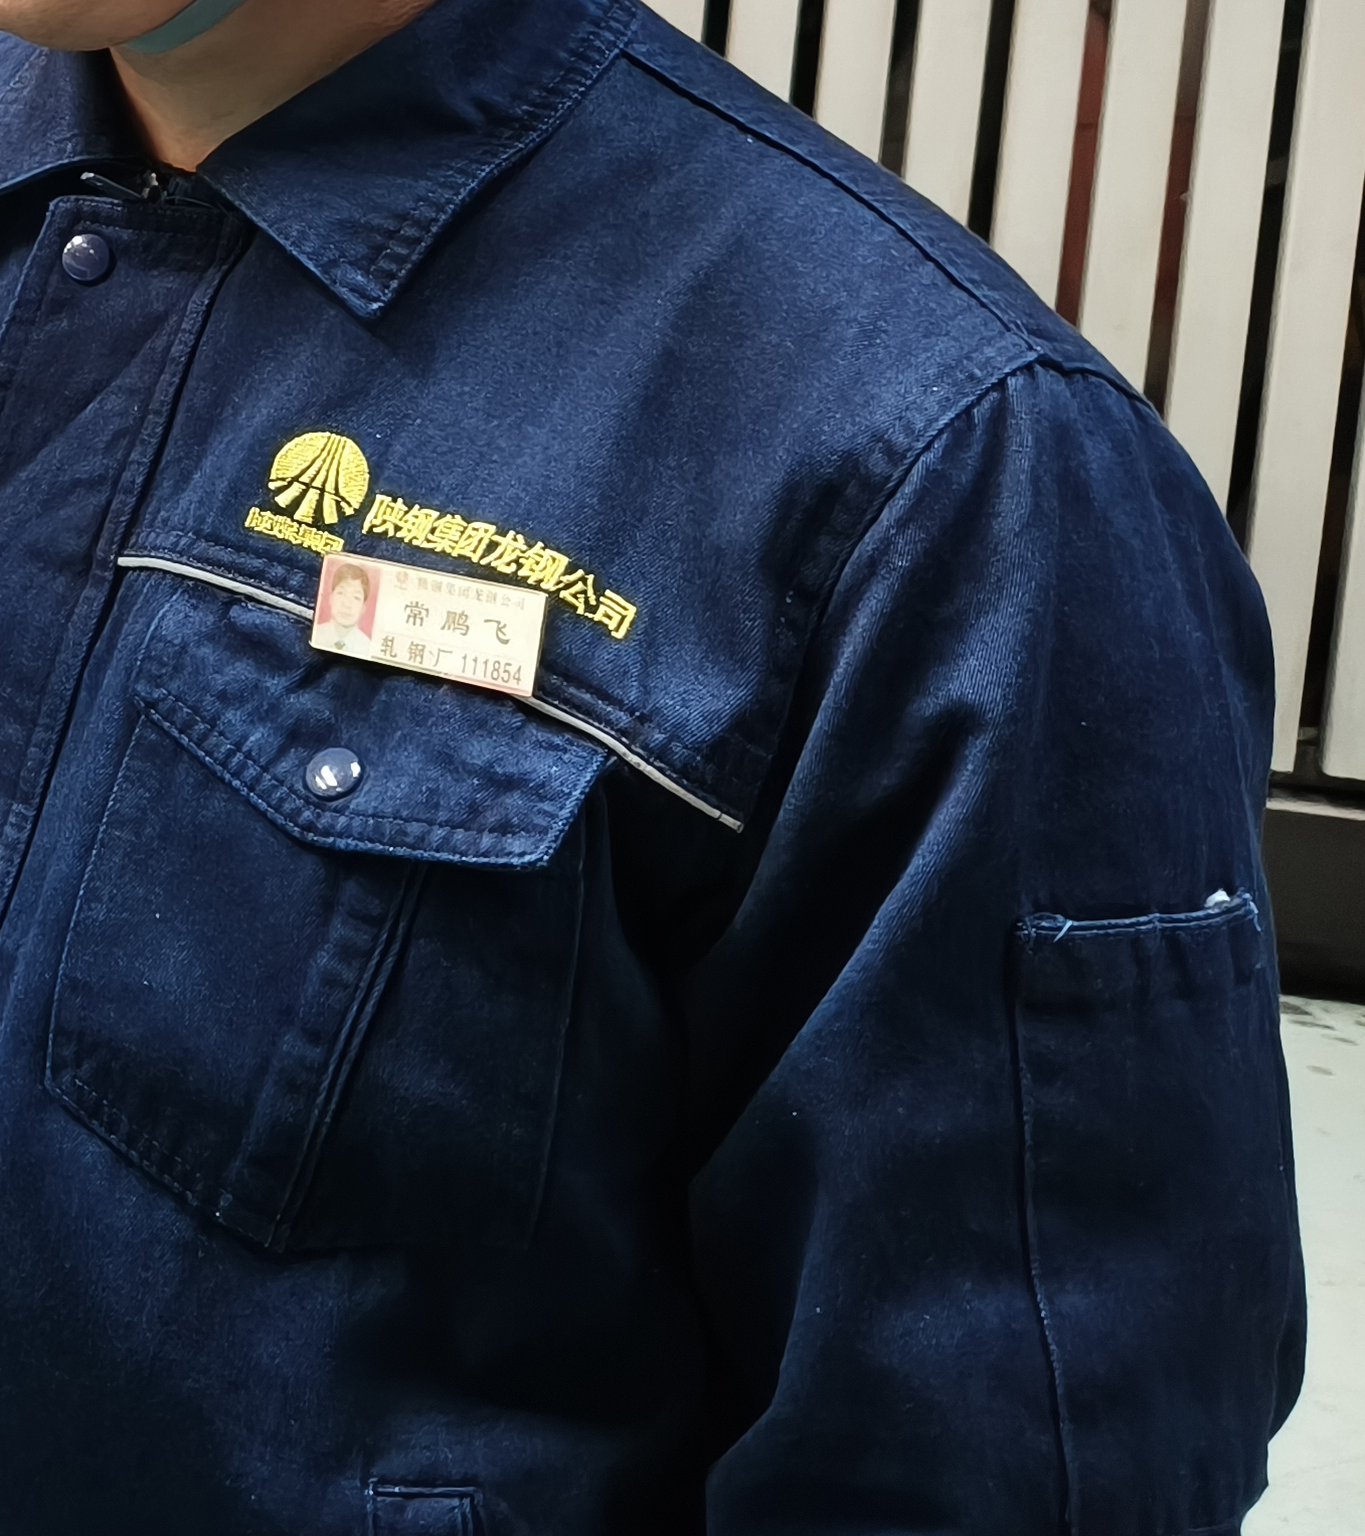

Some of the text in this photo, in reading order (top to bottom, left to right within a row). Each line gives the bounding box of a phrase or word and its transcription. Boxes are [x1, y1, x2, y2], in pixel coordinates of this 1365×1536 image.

[362, 494, 638, 640] 陕钢集团龙钢公司
[404, 601, 512, 646] 常鹏飞
[380, 635, 523, 686] 轧钢厂 111854
